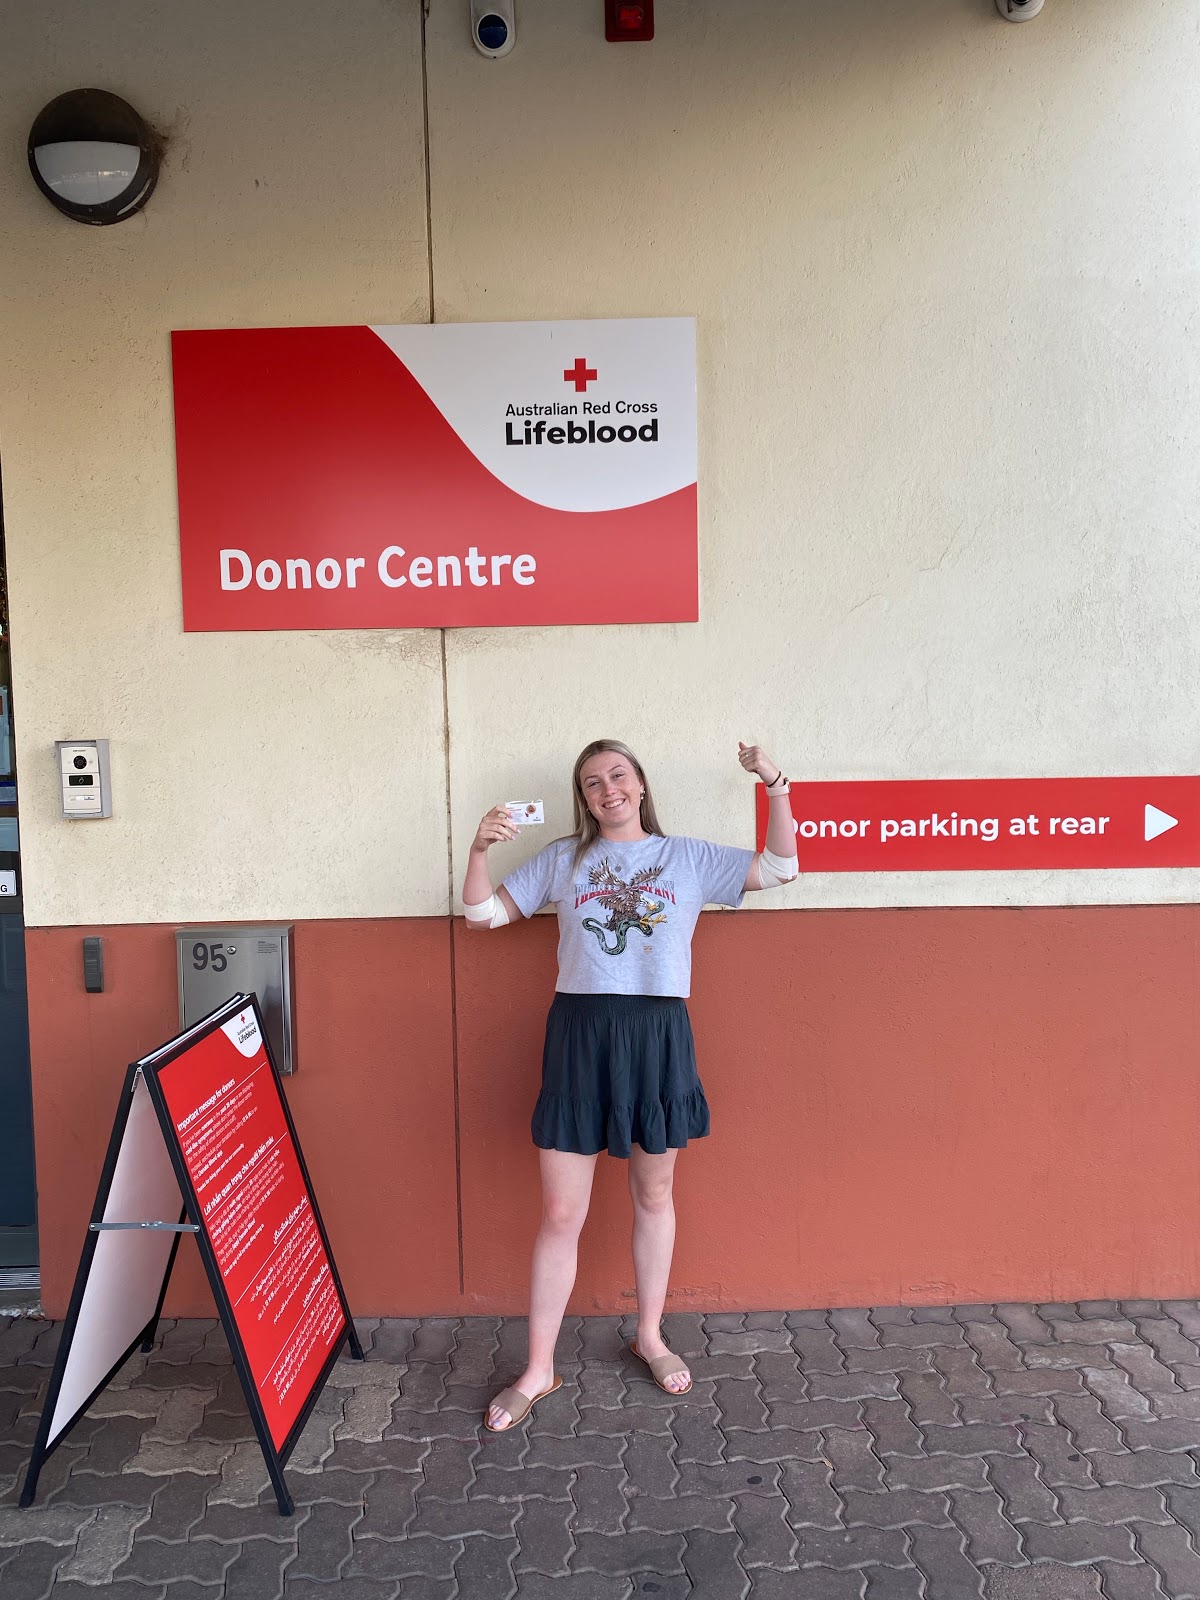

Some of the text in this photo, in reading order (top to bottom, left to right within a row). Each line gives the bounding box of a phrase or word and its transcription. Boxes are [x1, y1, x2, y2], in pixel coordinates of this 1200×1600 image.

[505, 400, 658, 417] Australian Red Cross
[505, 419, 659, 446] Lifeblood
[219, 544, 537, 591] Donor Centre
[880, 811, 999, 843] parking
[1009, 814, 1040, 836] at
[1049, 816, 1110, 835] rear
[192, 942, 228, 973] 95
[239, 1026, 256, 1043] Lifeblood
[177, 1109, 199, 1131] Important
[199, 1095, 216, 1113] message
[222, 1079, 235, 1093] donors
